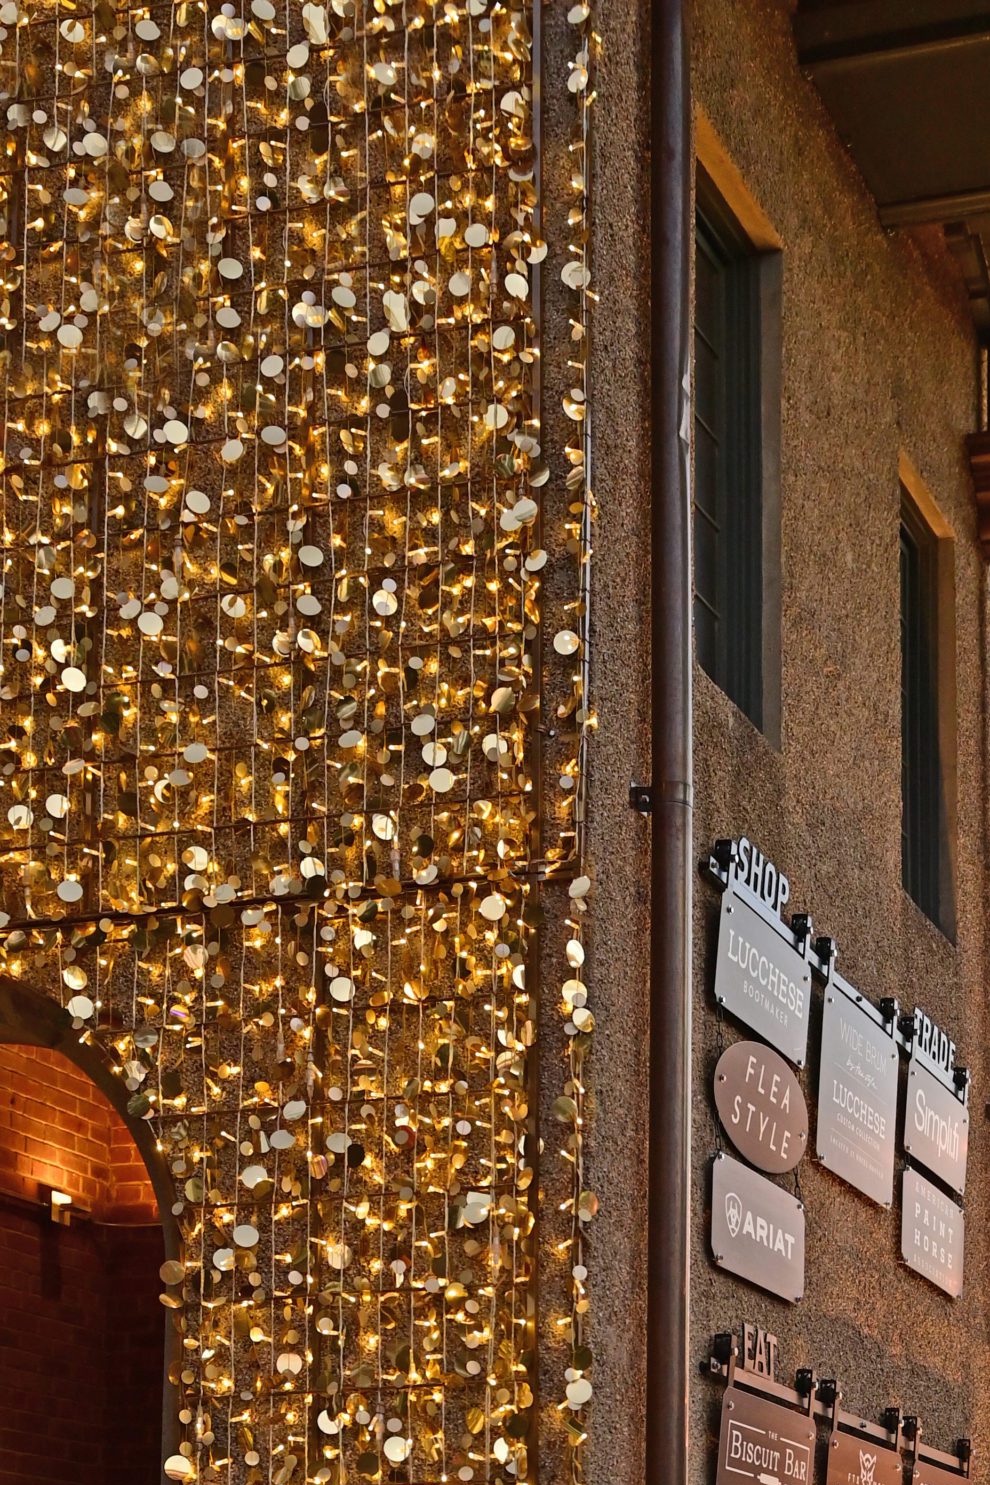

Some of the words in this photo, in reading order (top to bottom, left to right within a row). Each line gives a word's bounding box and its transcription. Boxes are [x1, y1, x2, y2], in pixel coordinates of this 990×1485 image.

[737, 836, 790, 916] SHOP
[727, 929, 804, 1018] LUCCHESE
[743, 980, 789, 1028] BOOTMAKER
[914, 1006, 956, 1074] TRADE
[745, 1055, 790, 1114] FLEA
[832, 1079, 886, 1139] LUCCHESE
[731, 1096, 791, 1160] STYLE
[742, 1211, 795, 1260] ARIAT
[914, 1202, 953, 1243] PAINT
[914, 1228, 953, 1270] HORSE
[743, 1323, 777, 1382] EAT
[768, 1431, 778, 1441] THE
